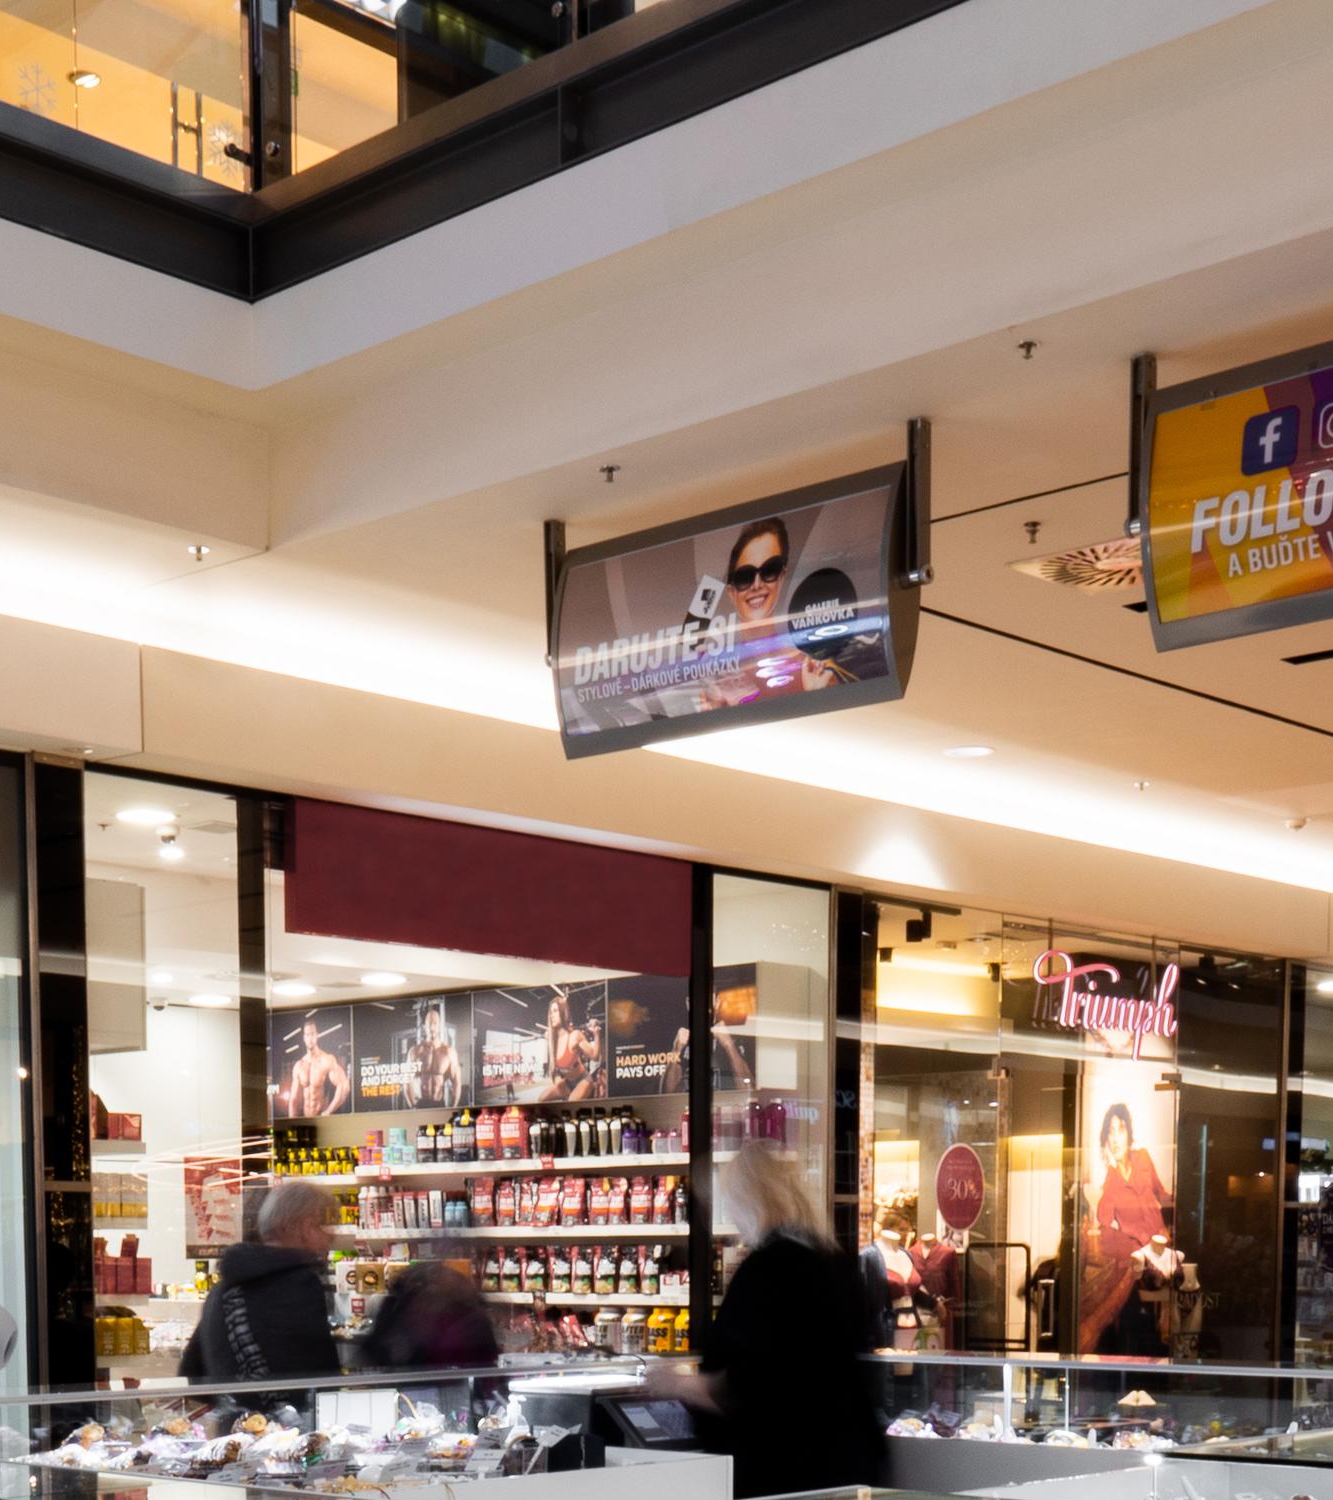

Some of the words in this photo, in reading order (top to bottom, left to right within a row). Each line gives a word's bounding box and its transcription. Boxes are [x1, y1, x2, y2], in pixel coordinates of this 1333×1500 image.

[1228, 549, 1243, 578] A
[1248, 533, 1321, 574] BUĎTE
[574, 621, 701, 685] DARUJTE
[706, 612, 738, 656] SI
[577, 678, 622, 703] STYLOVÉ
[631, 666, 680, 692] DÁRKOVÉ
[683, 655, 740, 681] POUKÁZKY
[1034, 950, 1180, 1061] Triumph
[616, 1055, 646, 1067] HARD
[648, 1051, 681, 1064] WORK
[616, 1066, 643, 1079] PAYS
[644, 1064, 666, 1078] OFF
